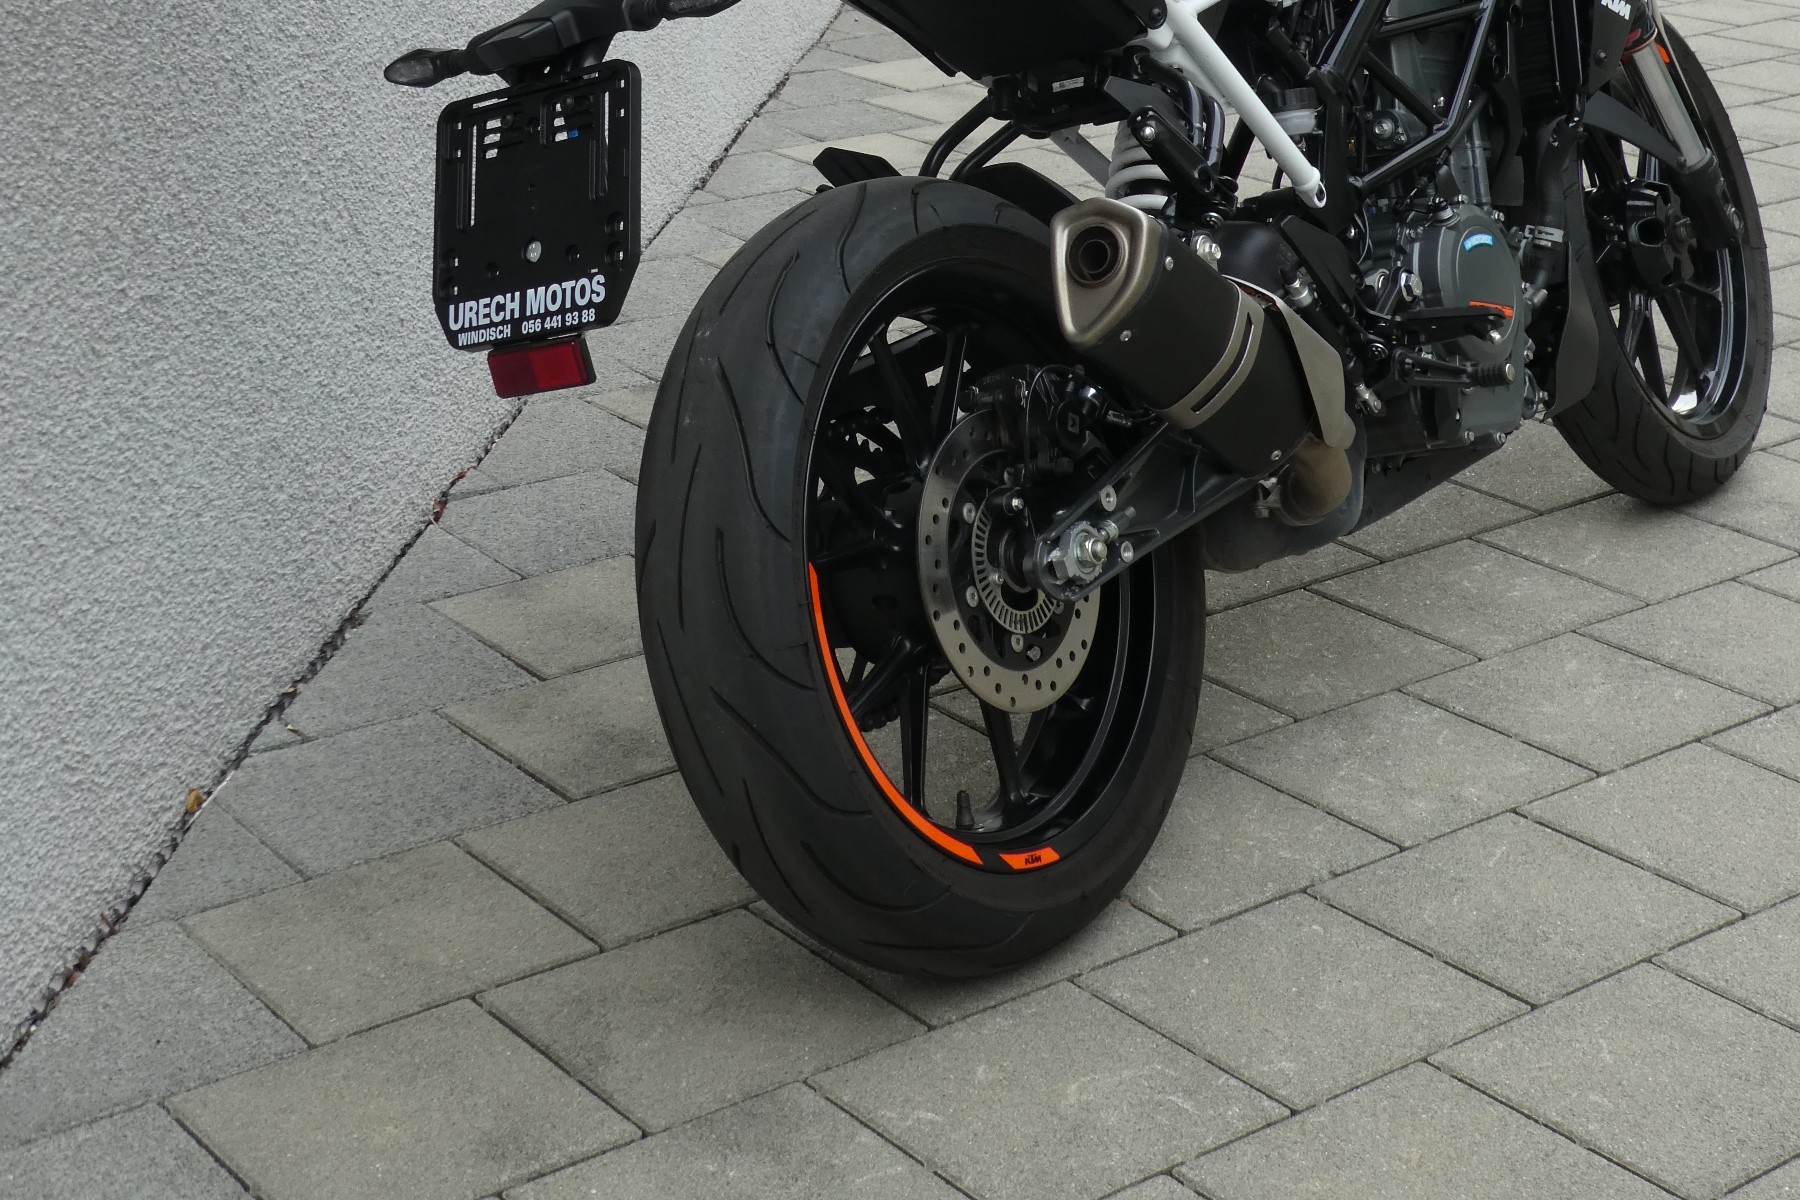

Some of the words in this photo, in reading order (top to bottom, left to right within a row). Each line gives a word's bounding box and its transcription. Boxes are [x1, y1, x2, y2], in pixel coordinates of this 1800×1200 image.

[448, 291, 520, 331] URECH
[525, 274, 606, 317] MOTOS
[458, 324, 511, 347] WINDISCH
[521, 319, 542, 335] 056
[544, 314, 562, 329] 441
[565, 310, 579, 326] 93
[581, 308, 596, 323] 88
[1025, 854, 1042, 865] KTM
